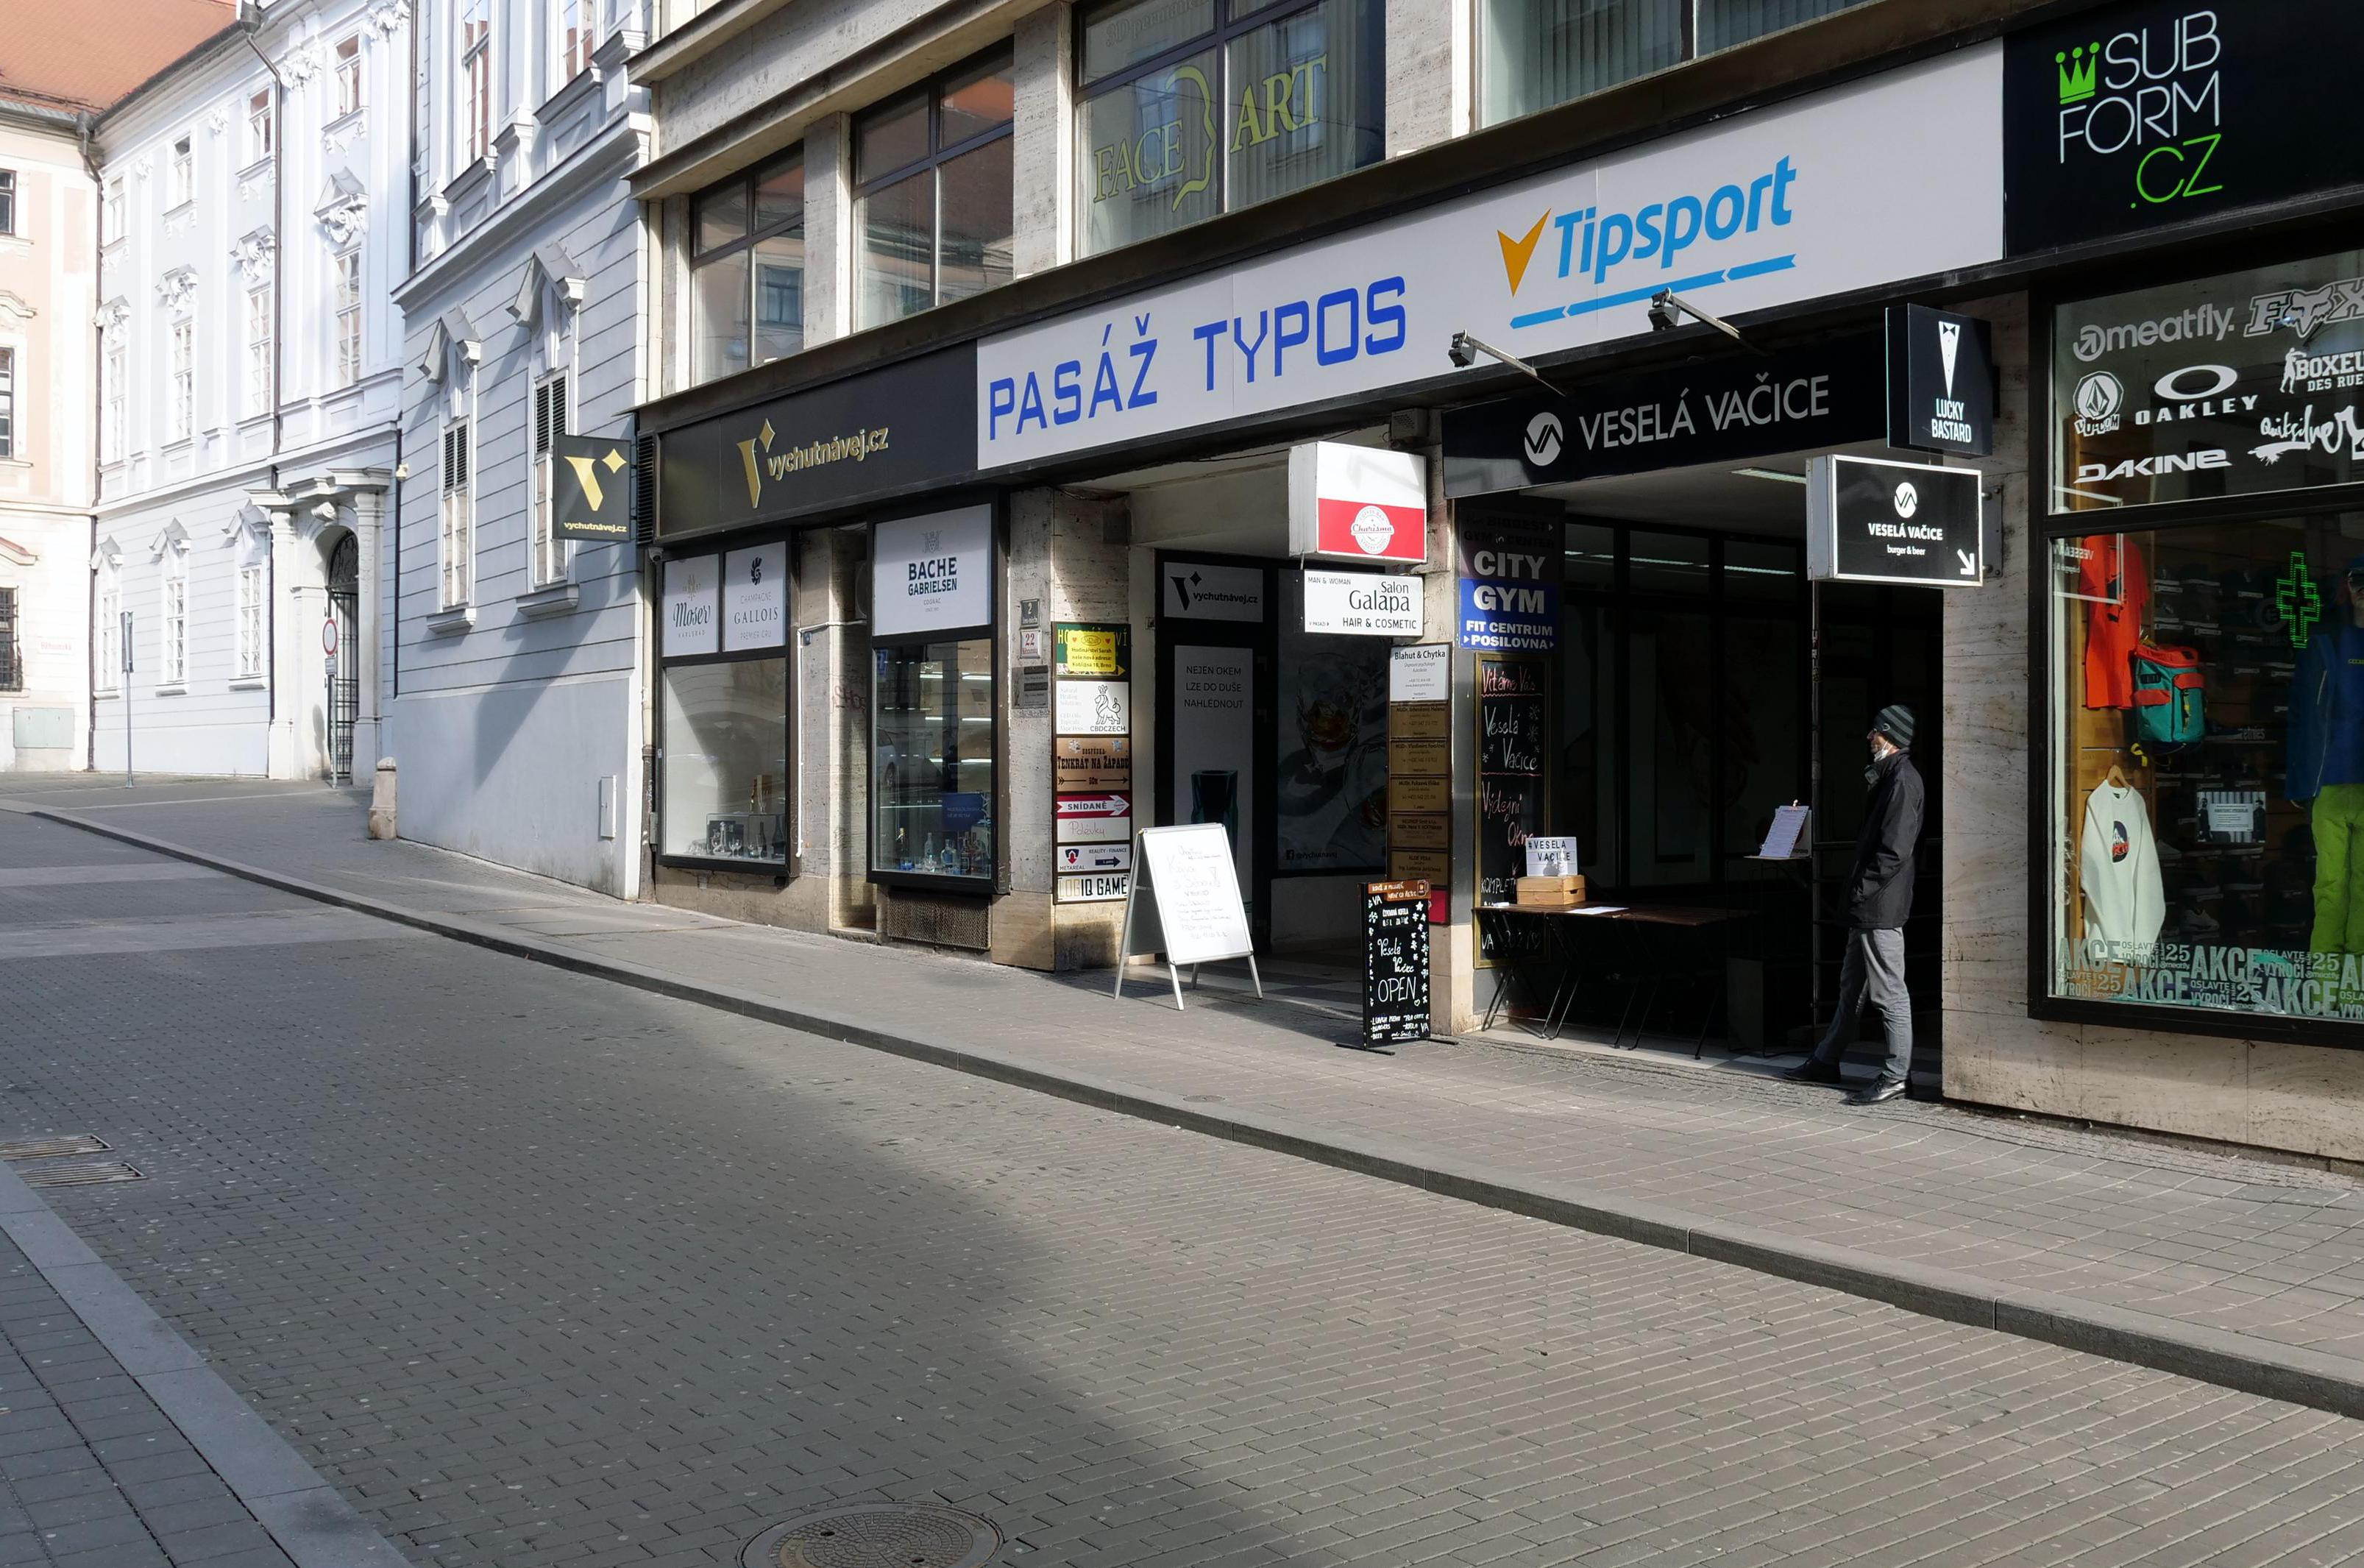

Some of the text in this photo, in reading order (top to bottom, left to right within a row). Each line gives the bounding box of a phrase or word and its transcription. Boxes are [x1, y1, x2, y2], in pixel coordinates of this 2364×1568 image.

[2105, 10, 2221, 90] SUB
[2060, 70, 2220, 164] FORM
[1093, 54, 1328, 203] FACE ART
[2131, 133, 2223, 209] .CZ
[1554, 155, 1797, 285] Tipsport
[990, 276, 1406, 440] PASÁŽ TYPOS
[2307, 378, 2332, 392] DES
[1579, 372, 1829, 450] VESELÁ VAČICE
[1935, 397, 1964, 422] LUCKY
[2135, 394, 2258, 426] OAKLEY
[1931, 418, 1972, 444] BASTARD
[767, 428, 889, 482] vychutnávej.cz
[564, 521, 627, 533] vychutnávej.cz
[1868, 523, 1943, 541] VESELÁ VAČICE
[1496, 535, 1505, 544] in
[1886, 544, 1906, 556] burger
[909, 557, 957, 581] BACHE
[1474, 550, 1545, 580] CITY
[908, 578, 957, 596] GABRIELSEN
[1308, 576, 1321, 584] MAN
[1380, 581, 1410, 594] Salon
[740, 592, 772, 604] CHAMPAGNE
[1193, 592, 1258, 605] vychutnávej.cz
[1349, 589, 1410, 614] Galapa
[1474, 585, 1544, 614] GYM
[673, 603, 711, 628] Moser
[734, 607, 778, 624] GALLOIS
[1028, 603, 1032, 614] 2
[1343, 617, 1417, 630] HAIR & COSMETIC
[1466, 620, 1552, 636] FIT CENTRUM
[1025, 634, 1035, 646] 22
[1472, 635, 1547, 648] POSILOVNA
[1394, 649, 1446, 660] Blahut & Chytka
[1186, 666, 1241, 675] NEJEN OKEM
[1186, 681, 1241, 692] LZE DO DUŠE
[1184, 698, 1243, 708] NAHLÉDNOUT
[1484, 704, 1520, 737] Veselá
[1057, 756, 1088, 770] TENKRÁT
[1092, 758, 1101, 769] NA
[1068, 801, 1107, 810] SNÍDANĚ
[1538, 852, 1571, 861] VACIE
[1059, 876, 1126, 898] LOGIQ GAME
[1372, 895, 1382, 906] VA
[2057, 937, 2121, 974] AKCE
[2122, 941, 2159, 951] OSLAVTE
[2165, 943, 2190, 962] 25
[2190, 945, 2263, 983] AKCE
[2263, 949, 2305, 959] OSLAVTE
[2312, 953, 2340, 971] 25
[2122, 948, 2159, 968] VÝROČÍ
[1377, 976, 1416, 1003] OPEN
[2056, 971, 2091, 980] OSLAVTE
[2096, 973, 2121, 992] 25
[2123, 968, 2190, 1004] AKCE
[2190, 981, 2229, 990] OSLAVTE
[2265, 977, 2340, 1018] AKCE
[1420, 1022, 1430, 1033] VA
